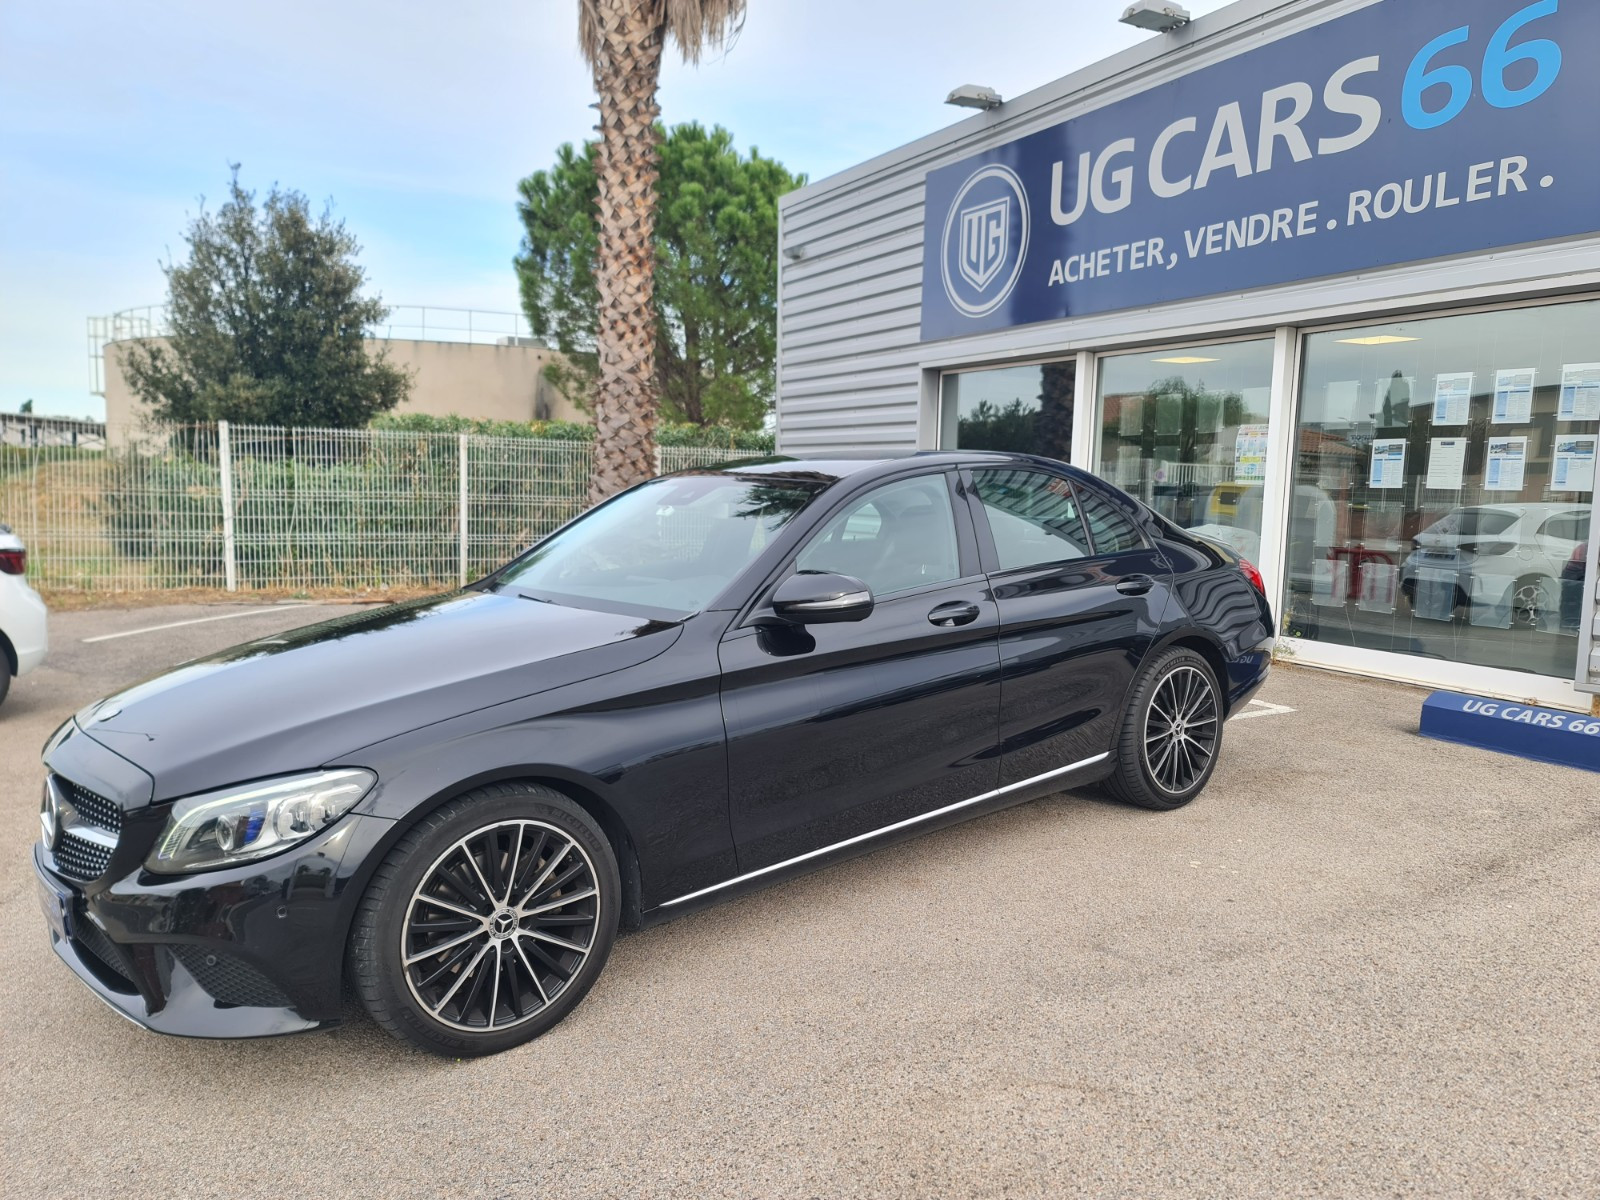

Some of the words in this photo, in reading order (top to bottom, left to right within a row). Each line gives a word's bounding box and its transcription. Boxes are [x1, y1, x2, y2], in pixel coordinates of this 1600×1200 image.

[1050, 138, 1135, 225] UG
[1149, 56, 1382, 197] CARS
[1402, 0, 1562, 130] 66
[1048, 238, 1178, 287] ACHETER,
[1346, 156, 1554, 226] ROULER.
[1462, 699, 1500, 716] UG
[1501, 707, 1568, 729] CARS
[1568, 719, 1600, 735] 66
[551, 809, 602, 851] MICHELIN
